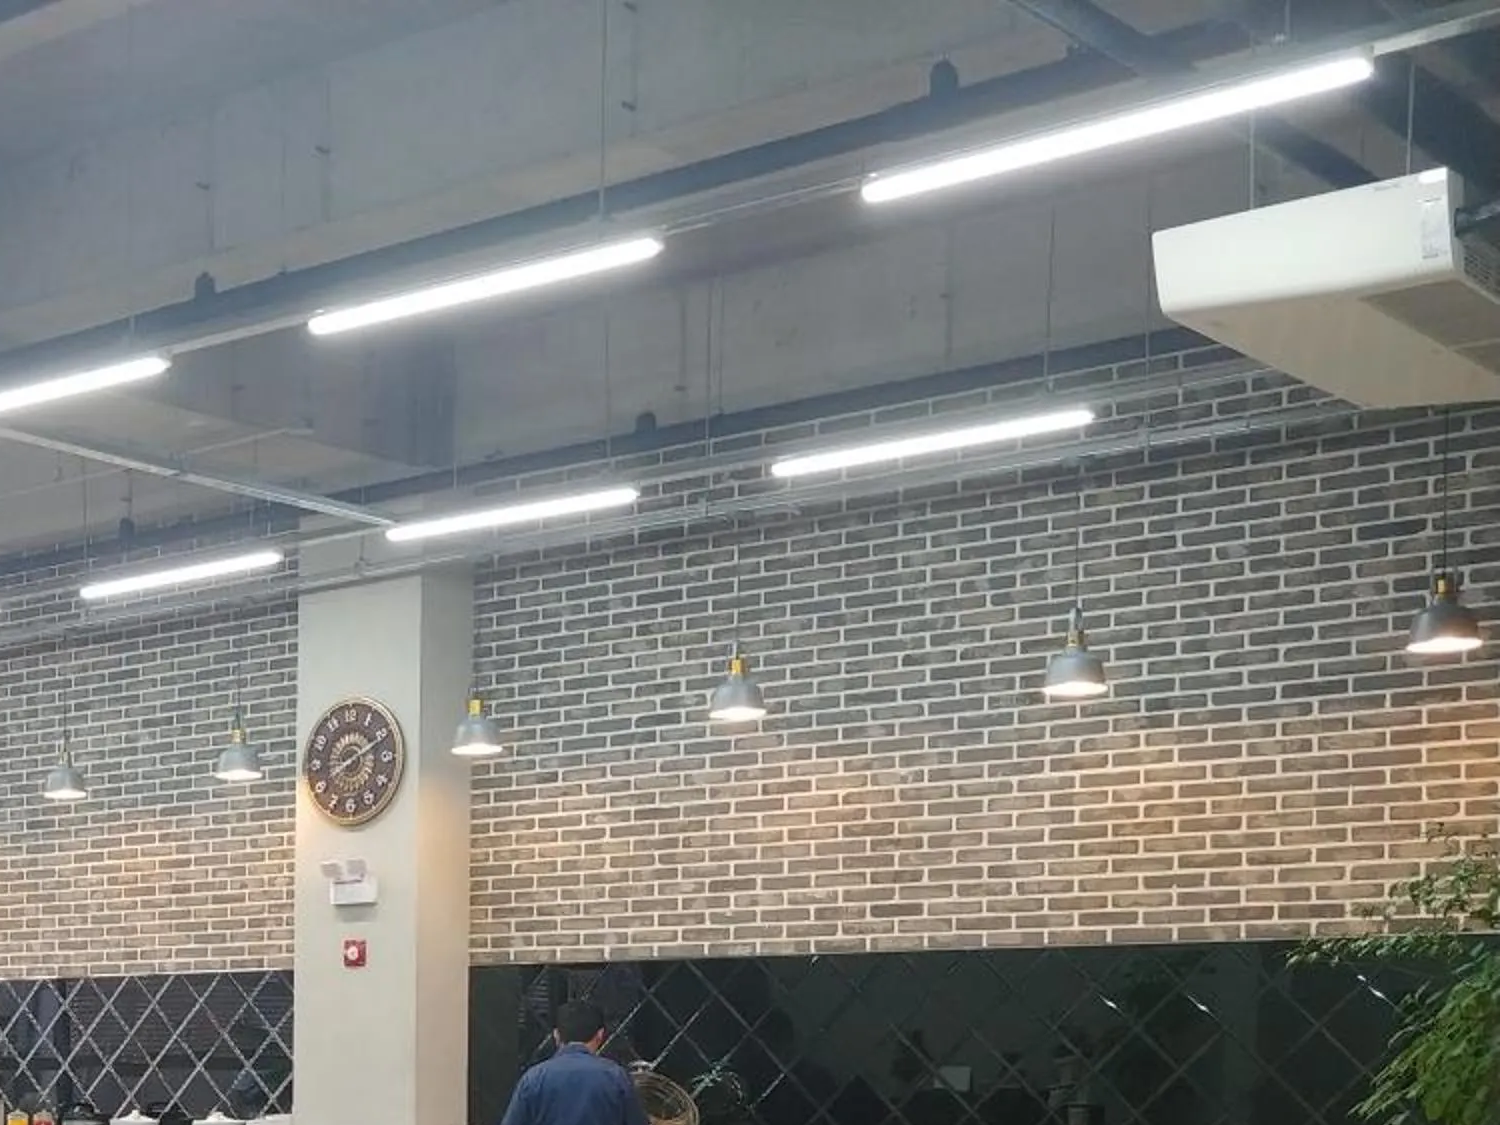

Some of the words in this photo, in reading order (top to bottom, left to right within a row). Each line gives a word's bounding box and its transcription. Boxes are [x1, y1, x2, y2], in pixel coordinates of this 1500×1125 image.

[345, 708, 357, 722] 12
[363, 712, 372, 726] 1
[346, 798, 356, 812] 6
